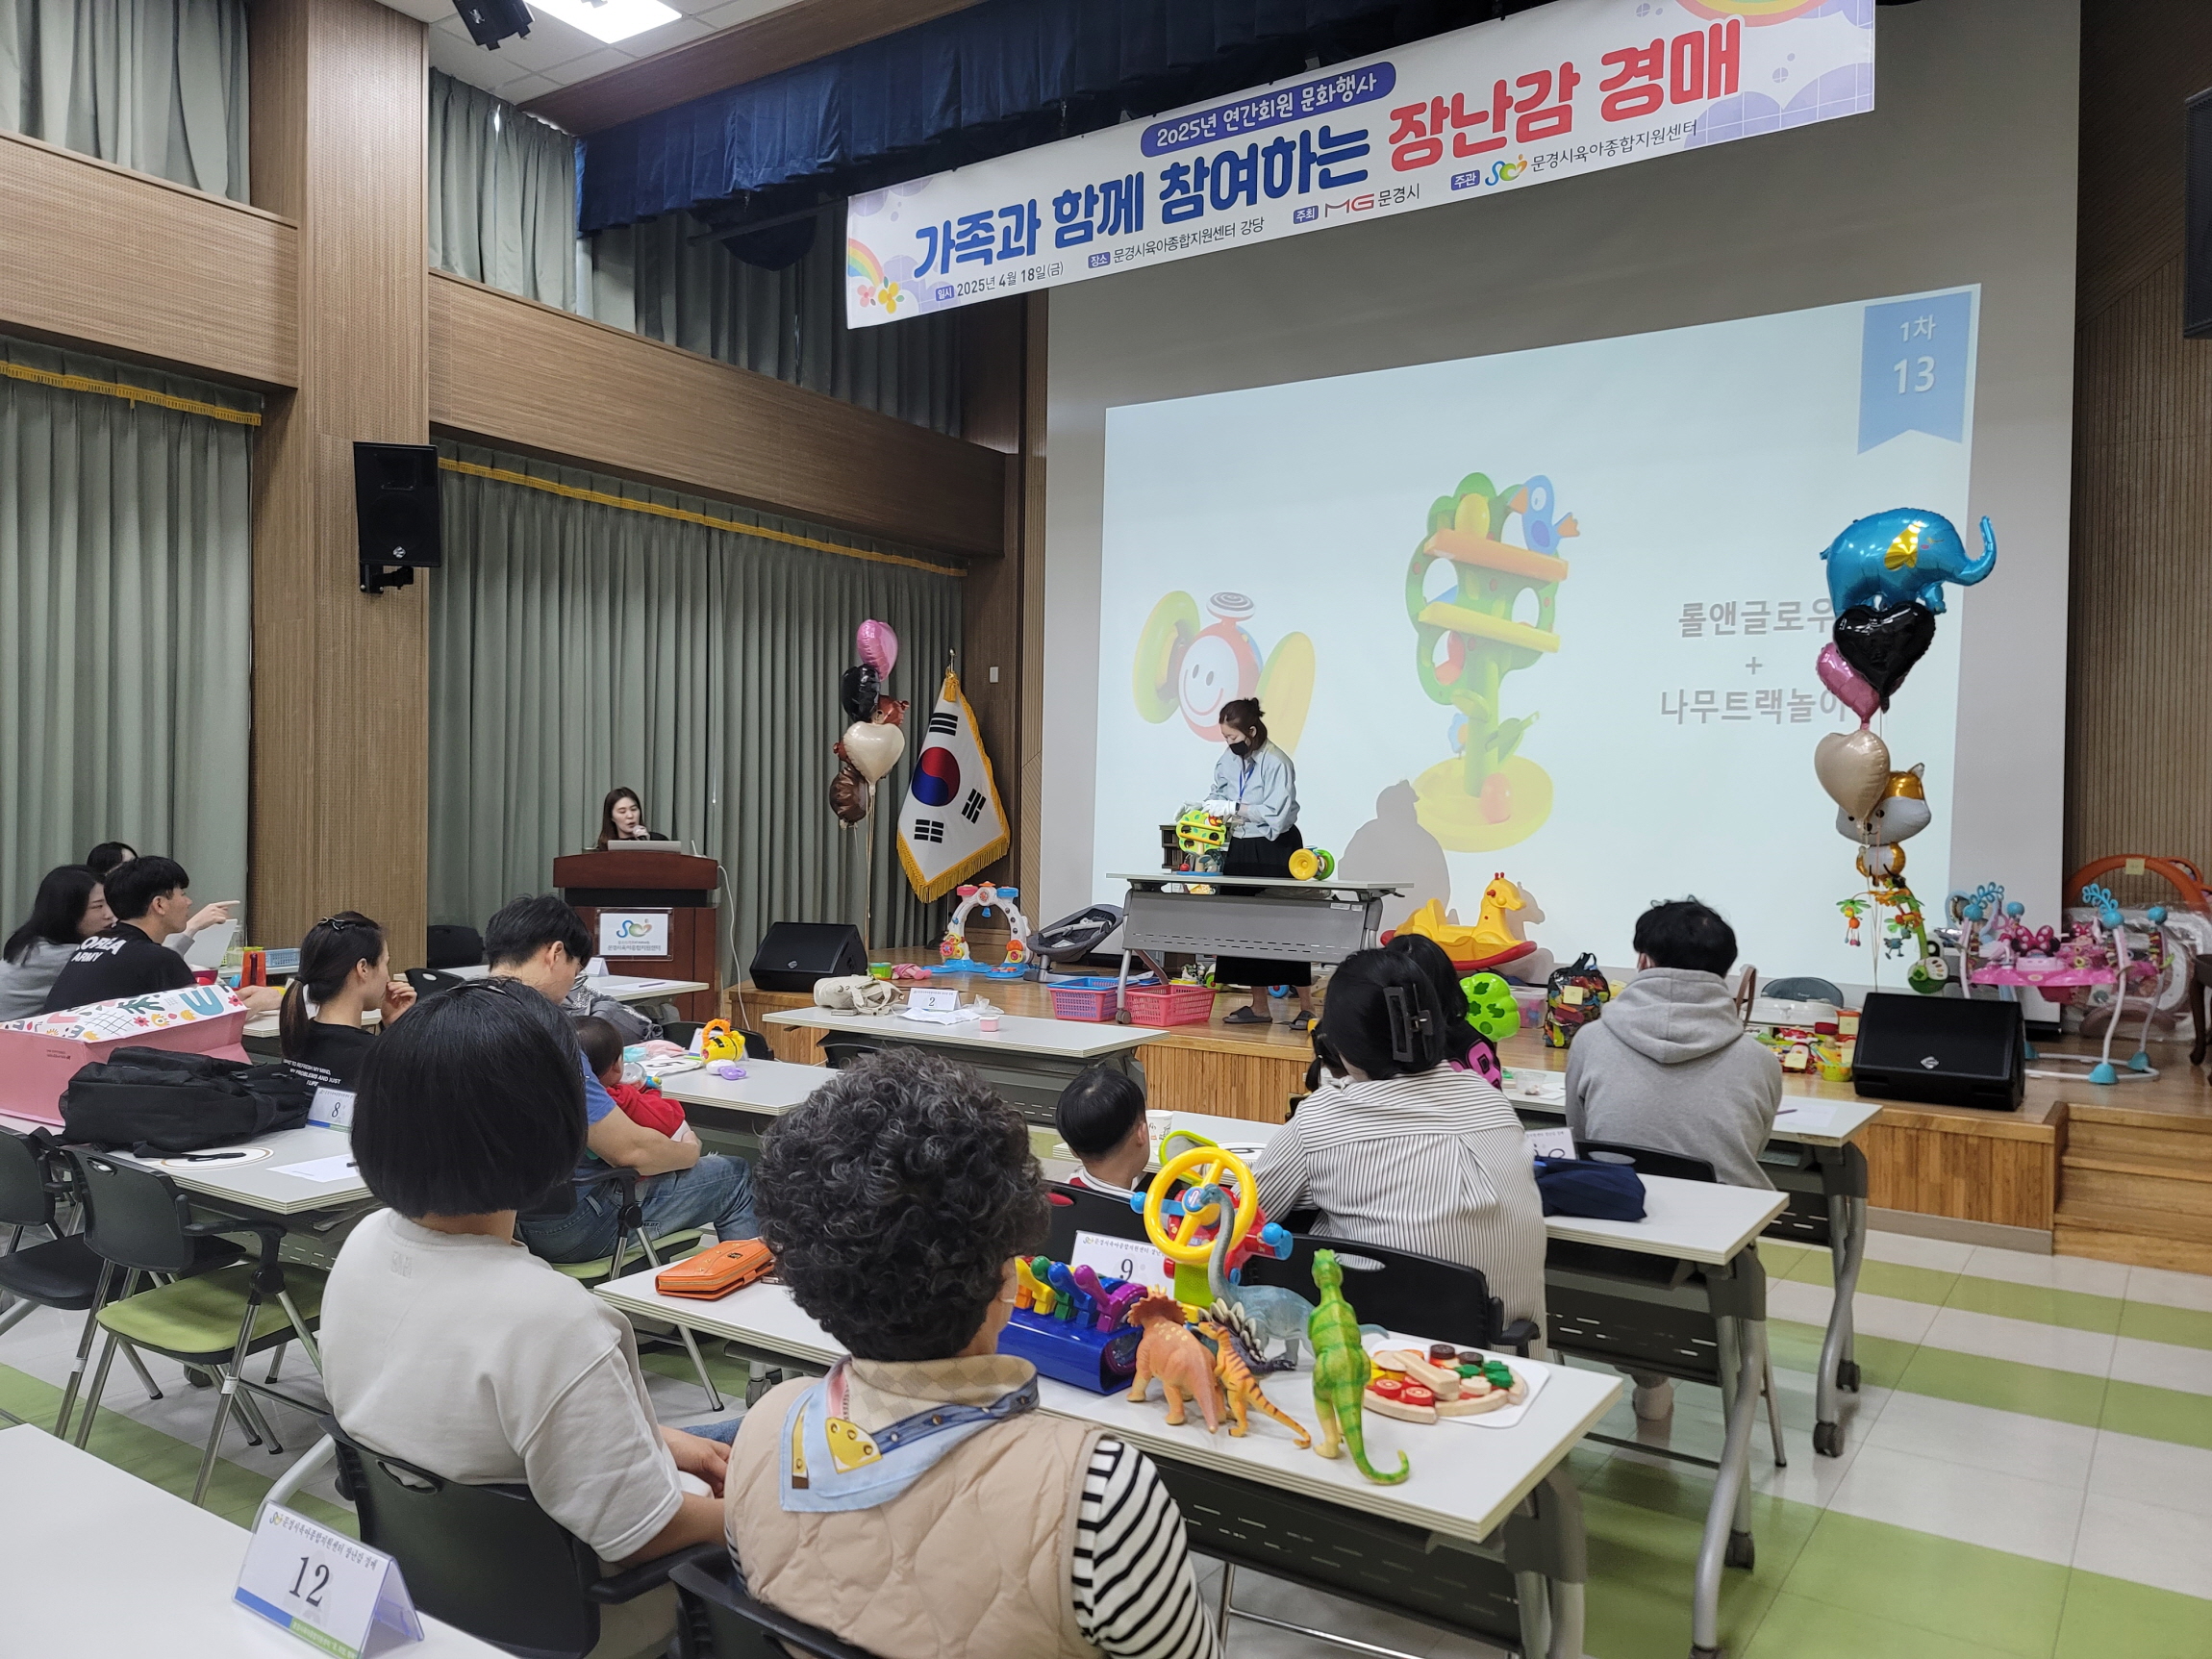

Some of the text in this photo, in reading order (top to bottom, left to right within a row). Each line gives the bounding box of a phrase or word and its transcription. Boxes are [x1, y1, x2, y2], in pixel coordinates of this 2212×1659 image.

[1156, 72, 1377, 147] 2025년 연간회원 문화행사
[912, 18, 1742, 279] 가족과 함께 참여하는 장난감 경매
[1453, 171, 1477, 189] 주관
[1530, 118, 1698, 172] 문경시육아종합지원센터
[1295, 183, 1420, 223] 주최 MG 문경시
[1090, 216, 1266, 267] 장소 문경시육아종합지원센터 강당
[937, 261, 1064, 300] 일시 2025년 4월 18일(금)
[1899, 314, 1937, 342] 1차
[1893, 355, 1936, 395] 13
[1678, 597, 1835, 639] 롤앤글로우
[1660, 688, 1848, 725] 나무트랙놀이
[70, 951, 105, 963] ARMY
[75, 935, 127, 956] OREA
[928, 996, 936, 1007] 2
[331, 1101, 341, 1118] 8
[1119, 1258, 1134, 1281] 9
[289, 1556, 330, 1608] 12
